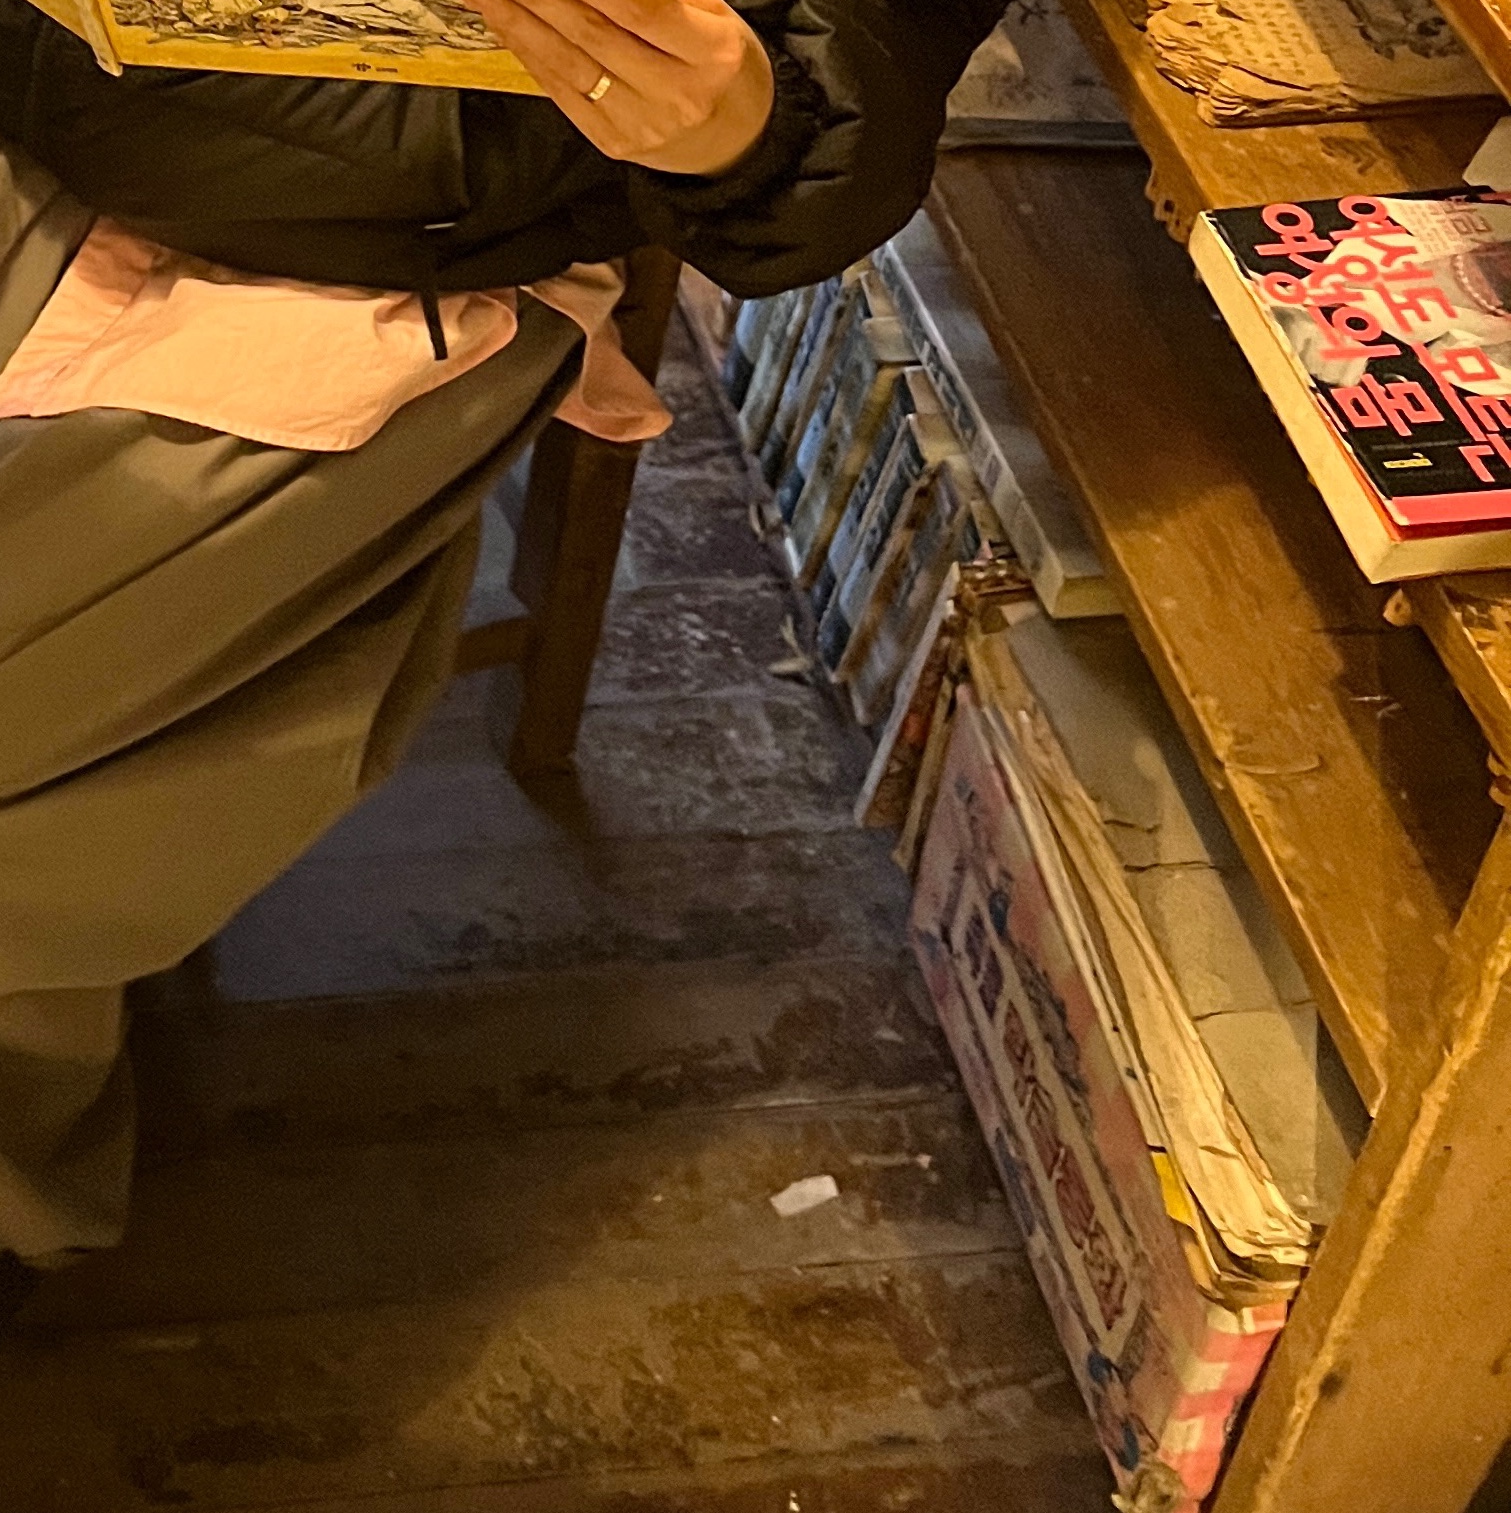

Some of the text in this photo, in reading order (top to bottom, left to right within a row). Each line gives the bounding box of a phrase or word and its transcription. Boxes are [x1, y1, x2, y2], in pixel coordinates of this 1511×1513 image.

[1254, 203, 1444, 437] 여성의 몸
[1330, 195, 1457, 333] 여성도
